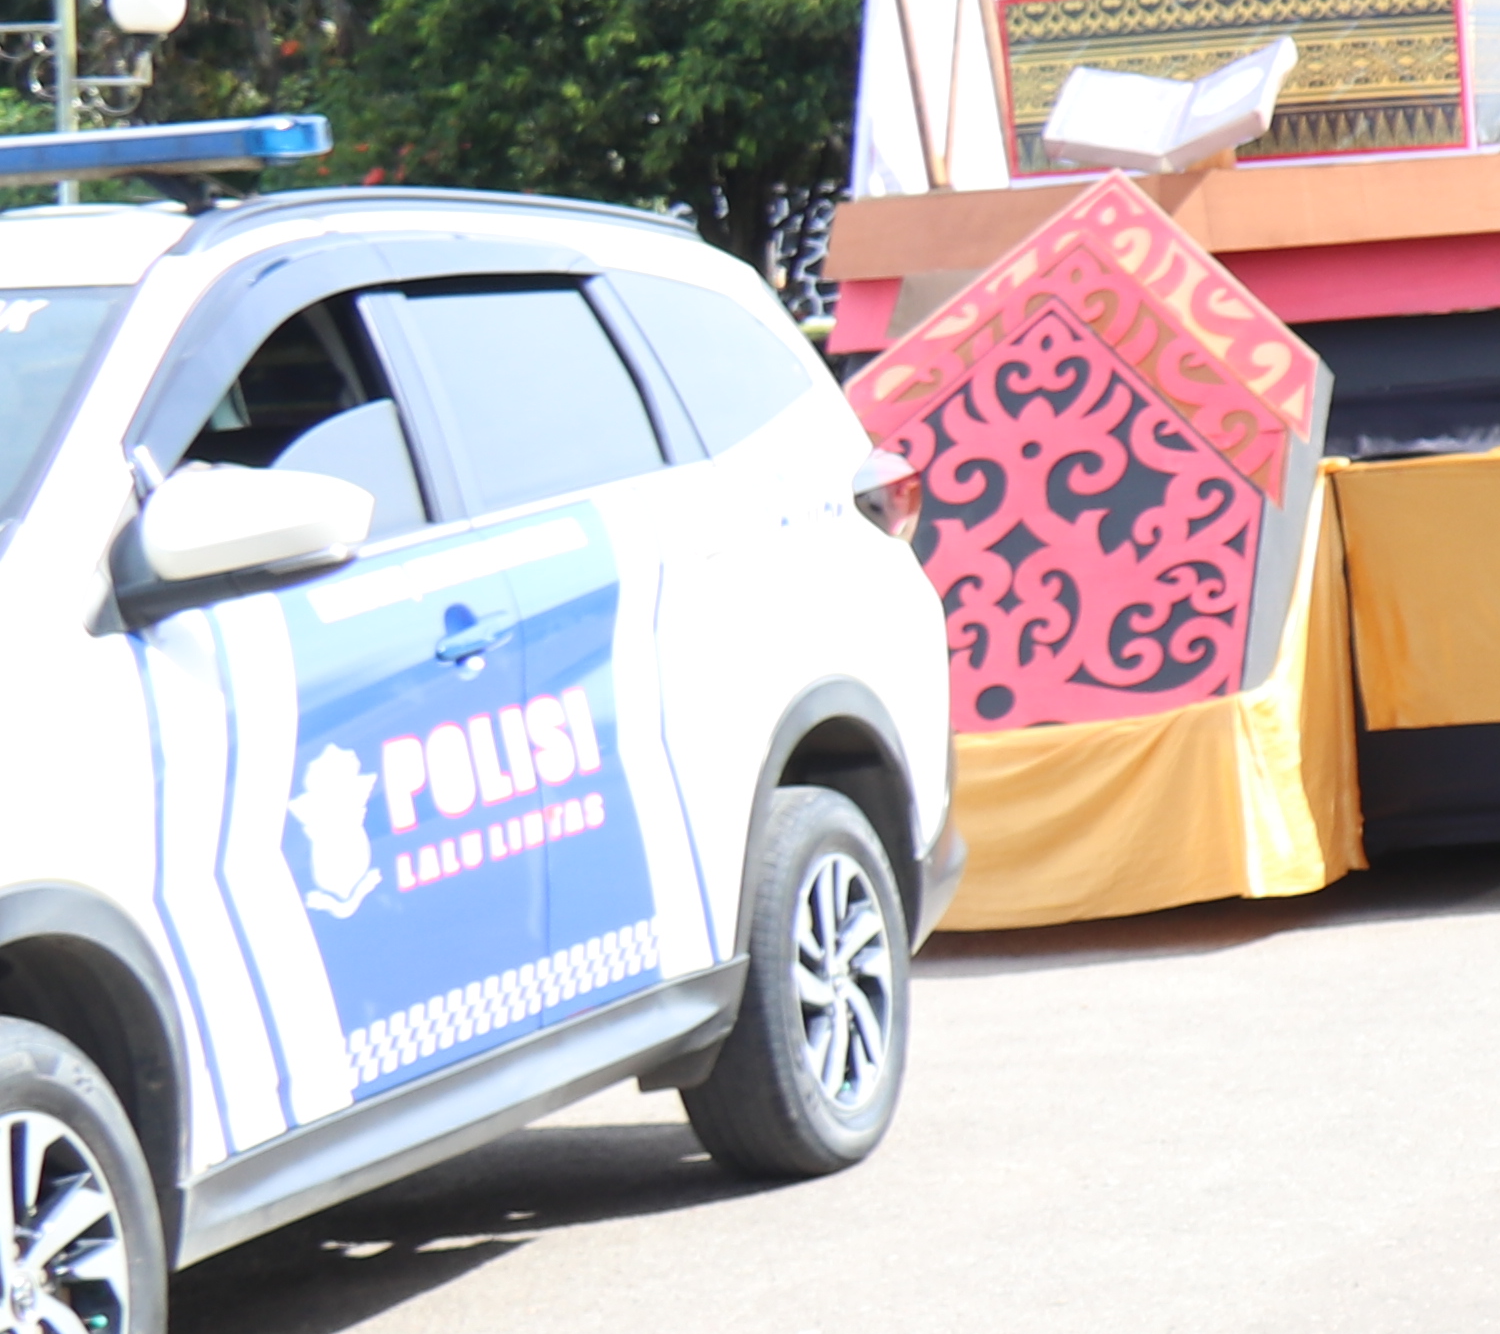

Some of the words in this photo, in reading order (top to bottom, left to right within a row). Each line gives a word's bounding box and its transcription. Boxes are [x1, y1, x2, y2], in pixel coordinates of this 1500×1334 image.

[382, 685, 602, 835] POLISI
[396, 829, 484, 892] LALU
[487, 792, 606, 862] LINTAS
